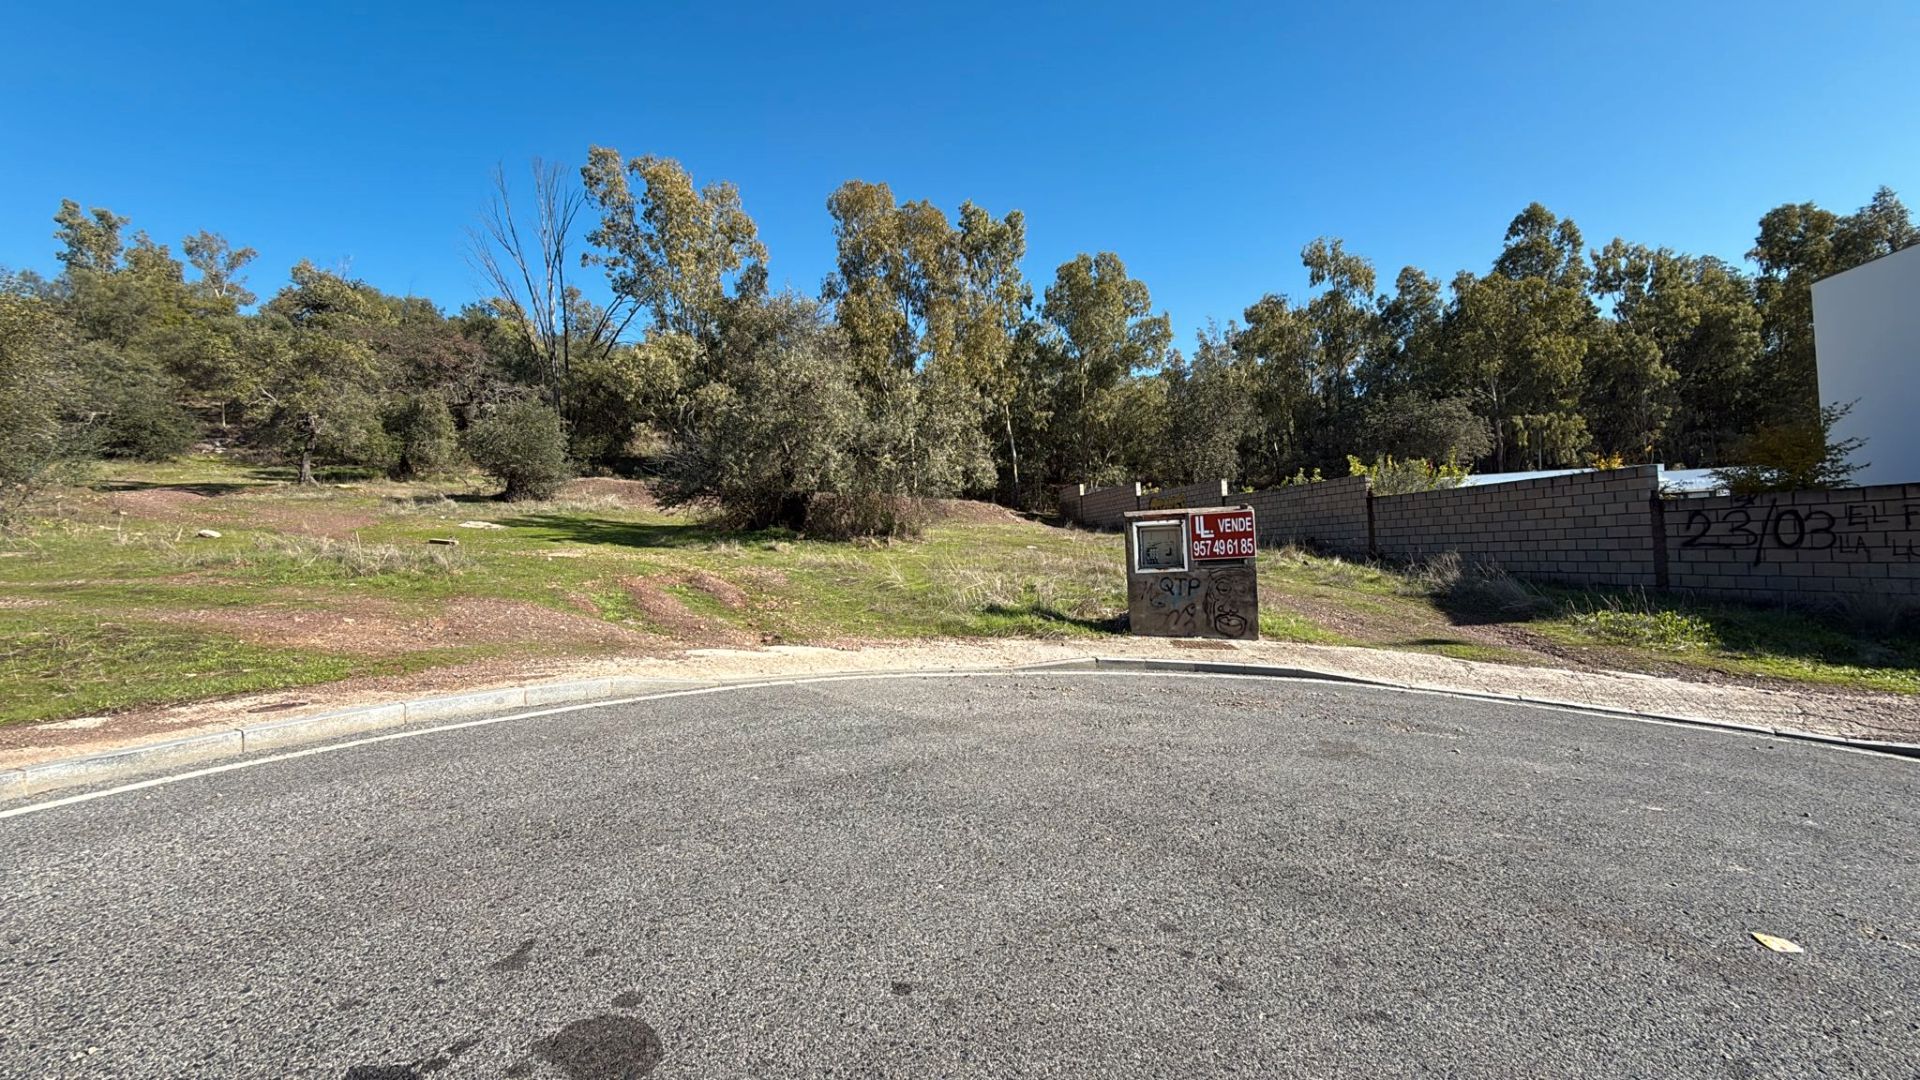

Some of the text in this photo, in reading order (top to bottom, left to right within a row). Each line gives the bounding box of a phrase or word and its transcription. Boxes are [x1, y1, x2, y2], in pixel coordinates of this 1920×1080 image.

[1217, 516, 1253, 533] VENDE
[1848, 504, 1889, 526] EL
[1681, 497, 1837, 567] 23/03
[1193, 537, 1254, 557] 957 49 61 85
